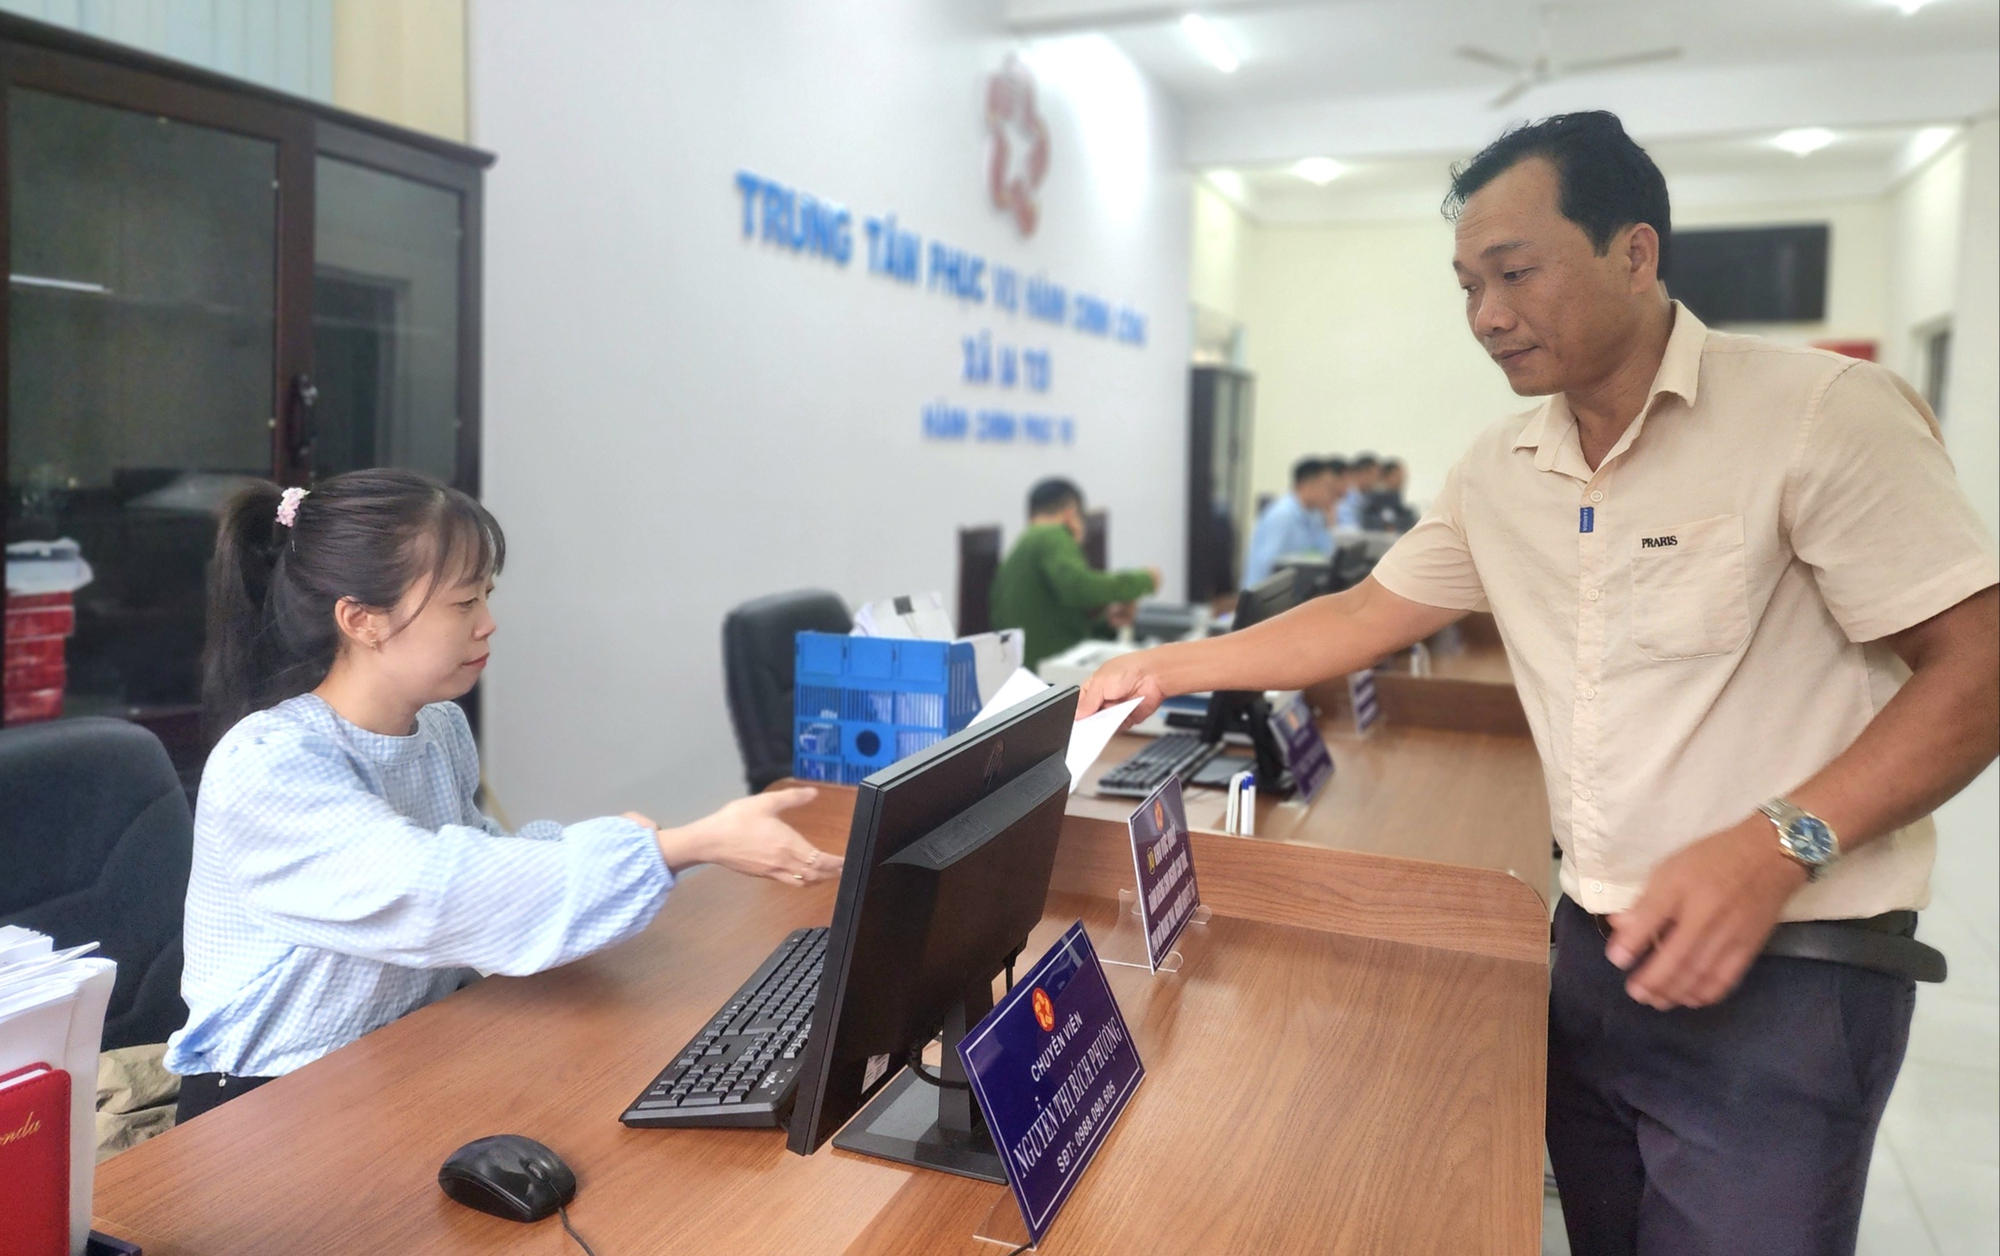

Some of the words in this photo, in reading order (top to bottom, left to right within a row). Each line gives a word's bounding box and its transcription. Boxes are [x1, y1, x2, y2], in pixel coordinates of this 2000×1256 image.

[734, 168, 853, 265] TRUNG
[1641, 535, 1678, 549] PRARIS
[1031, 1036, 1066, 1082] CHUYÊN
[1064, 1010, 1084, 1042] VIÊN
[1052, 1082, 1079, 1116] THỊ
[1067, 1052, 1095, 1103] BÍCH
[0, 1111, 42, 1146] nda
[1057, 1140, 1078, 1174] SĐT:
[1074, 1080, 1116, 1147] 0988.090.605
